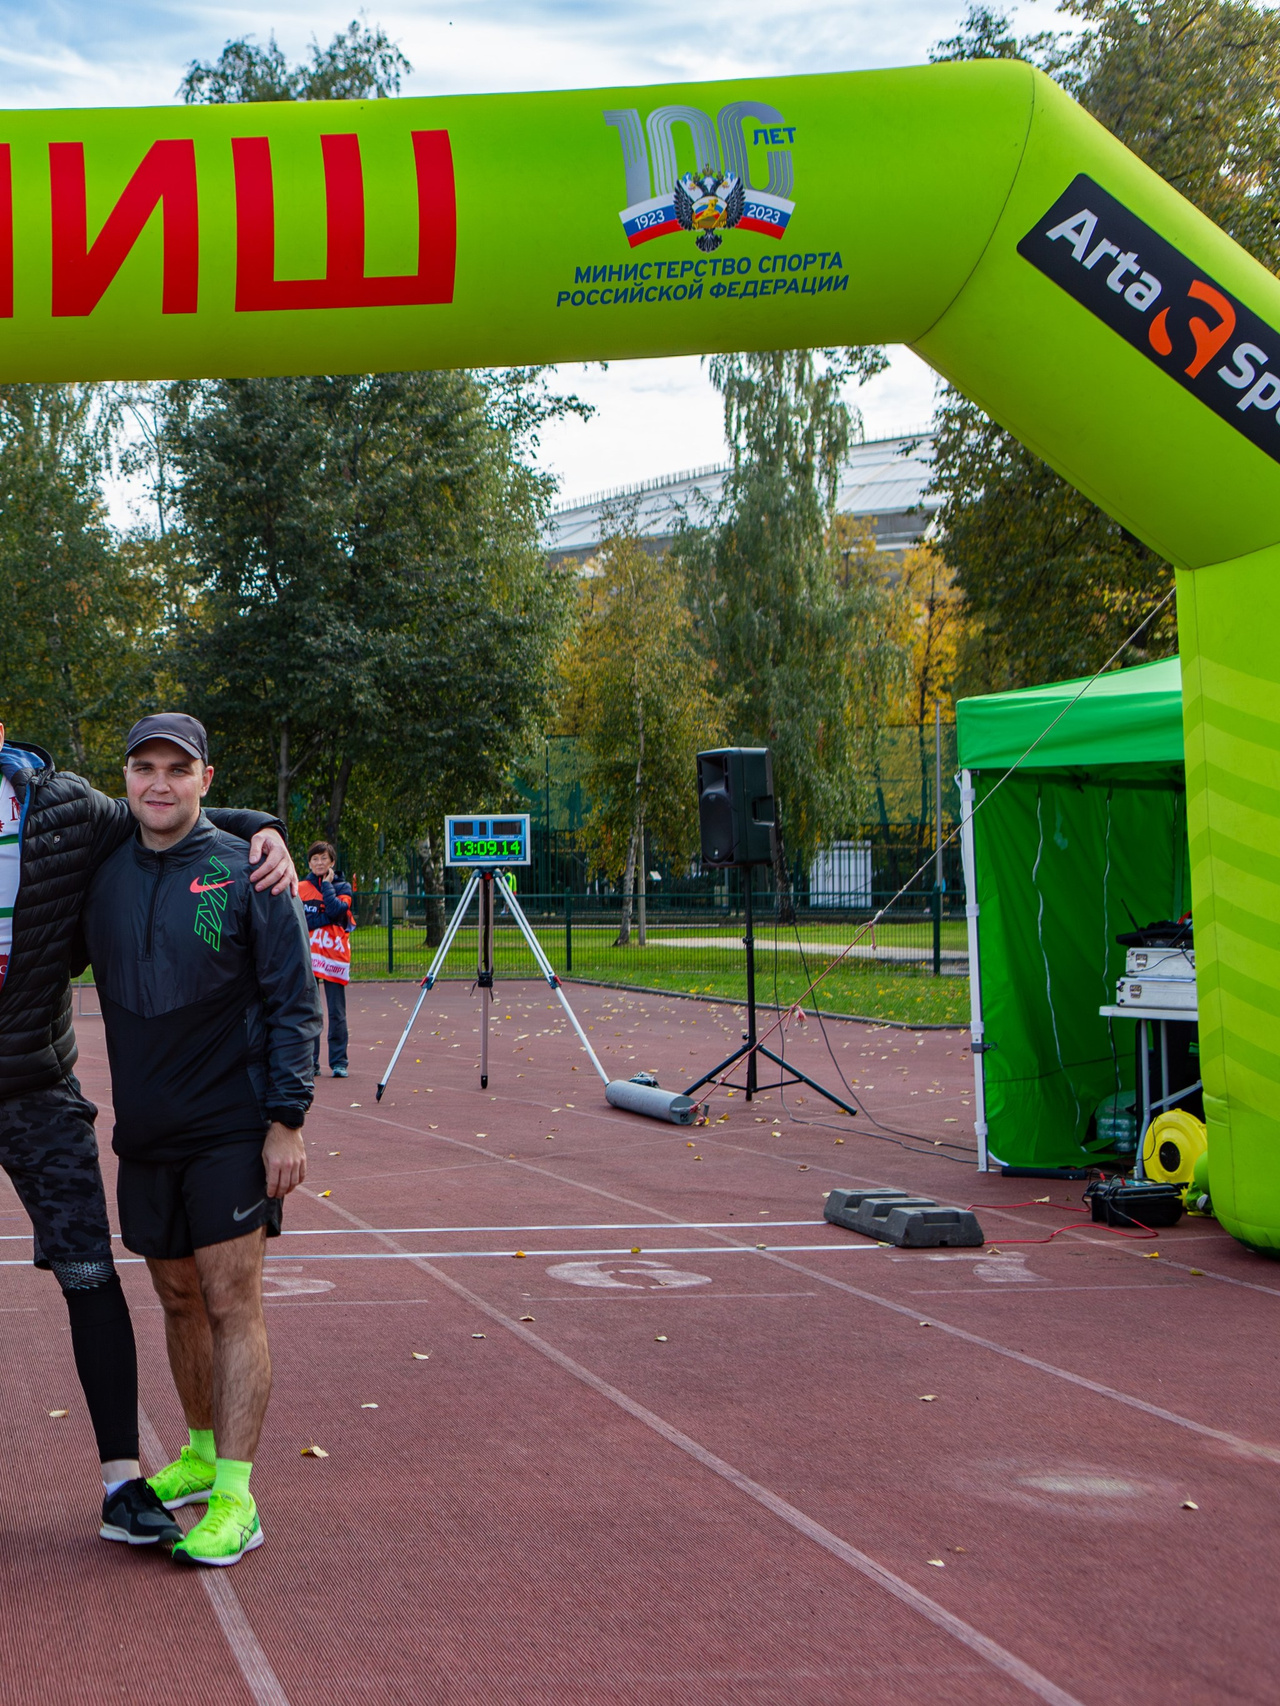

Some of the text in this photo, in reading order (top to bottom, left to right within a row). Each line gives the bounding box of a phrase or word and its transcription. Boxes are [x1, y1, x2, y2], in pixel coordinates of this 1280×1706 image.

[753, 127, 797, 146] ЛЕТ
[634, 209, 666, 230] 1923
[746, 204, 781, 224] 2023
[574, 251, 844, 284] МИНИСТЕРСТВО СПОРТА
[1045, 208, 1162, 312] Arta
[556, 275, 850, 307] РОССИЙСКОЙ ФЕДЕРАЦИИ
[1217, 342, 1280, 427] Sp
[455, 840, 520, 856] 13:09.14
[544, 1260, 713, 1290] 6
